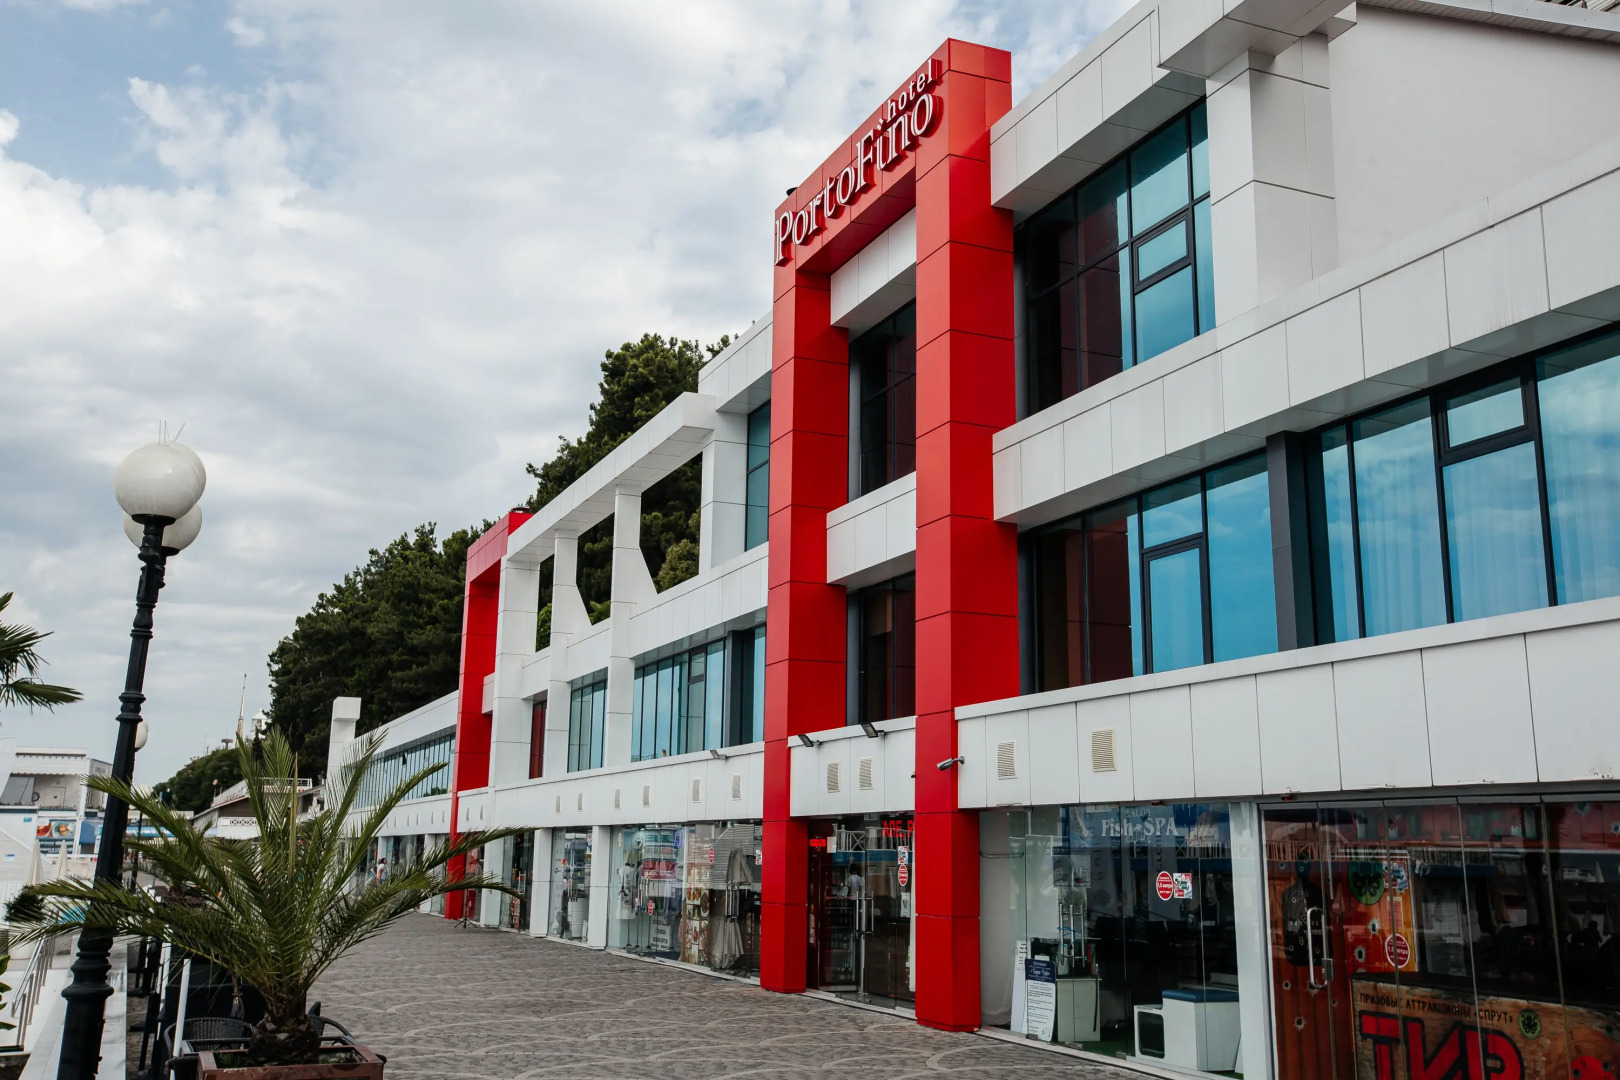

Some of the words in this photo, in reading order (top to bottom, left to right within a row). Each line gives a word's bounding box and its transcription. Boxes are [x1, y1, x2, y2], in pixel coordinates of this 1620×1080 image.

[887, 58, 934, 123] hotel
[775, 93, 936, 266] PortoFino
[1101, 818, 1134, 837] Fish
[1144, 817, 1178, 836] SPA
[1360, 992, 1403, 1009] ПРИЗОВЫ
[1406, 1000, 1472, 1017] АТТРАКЦИОНЫ
